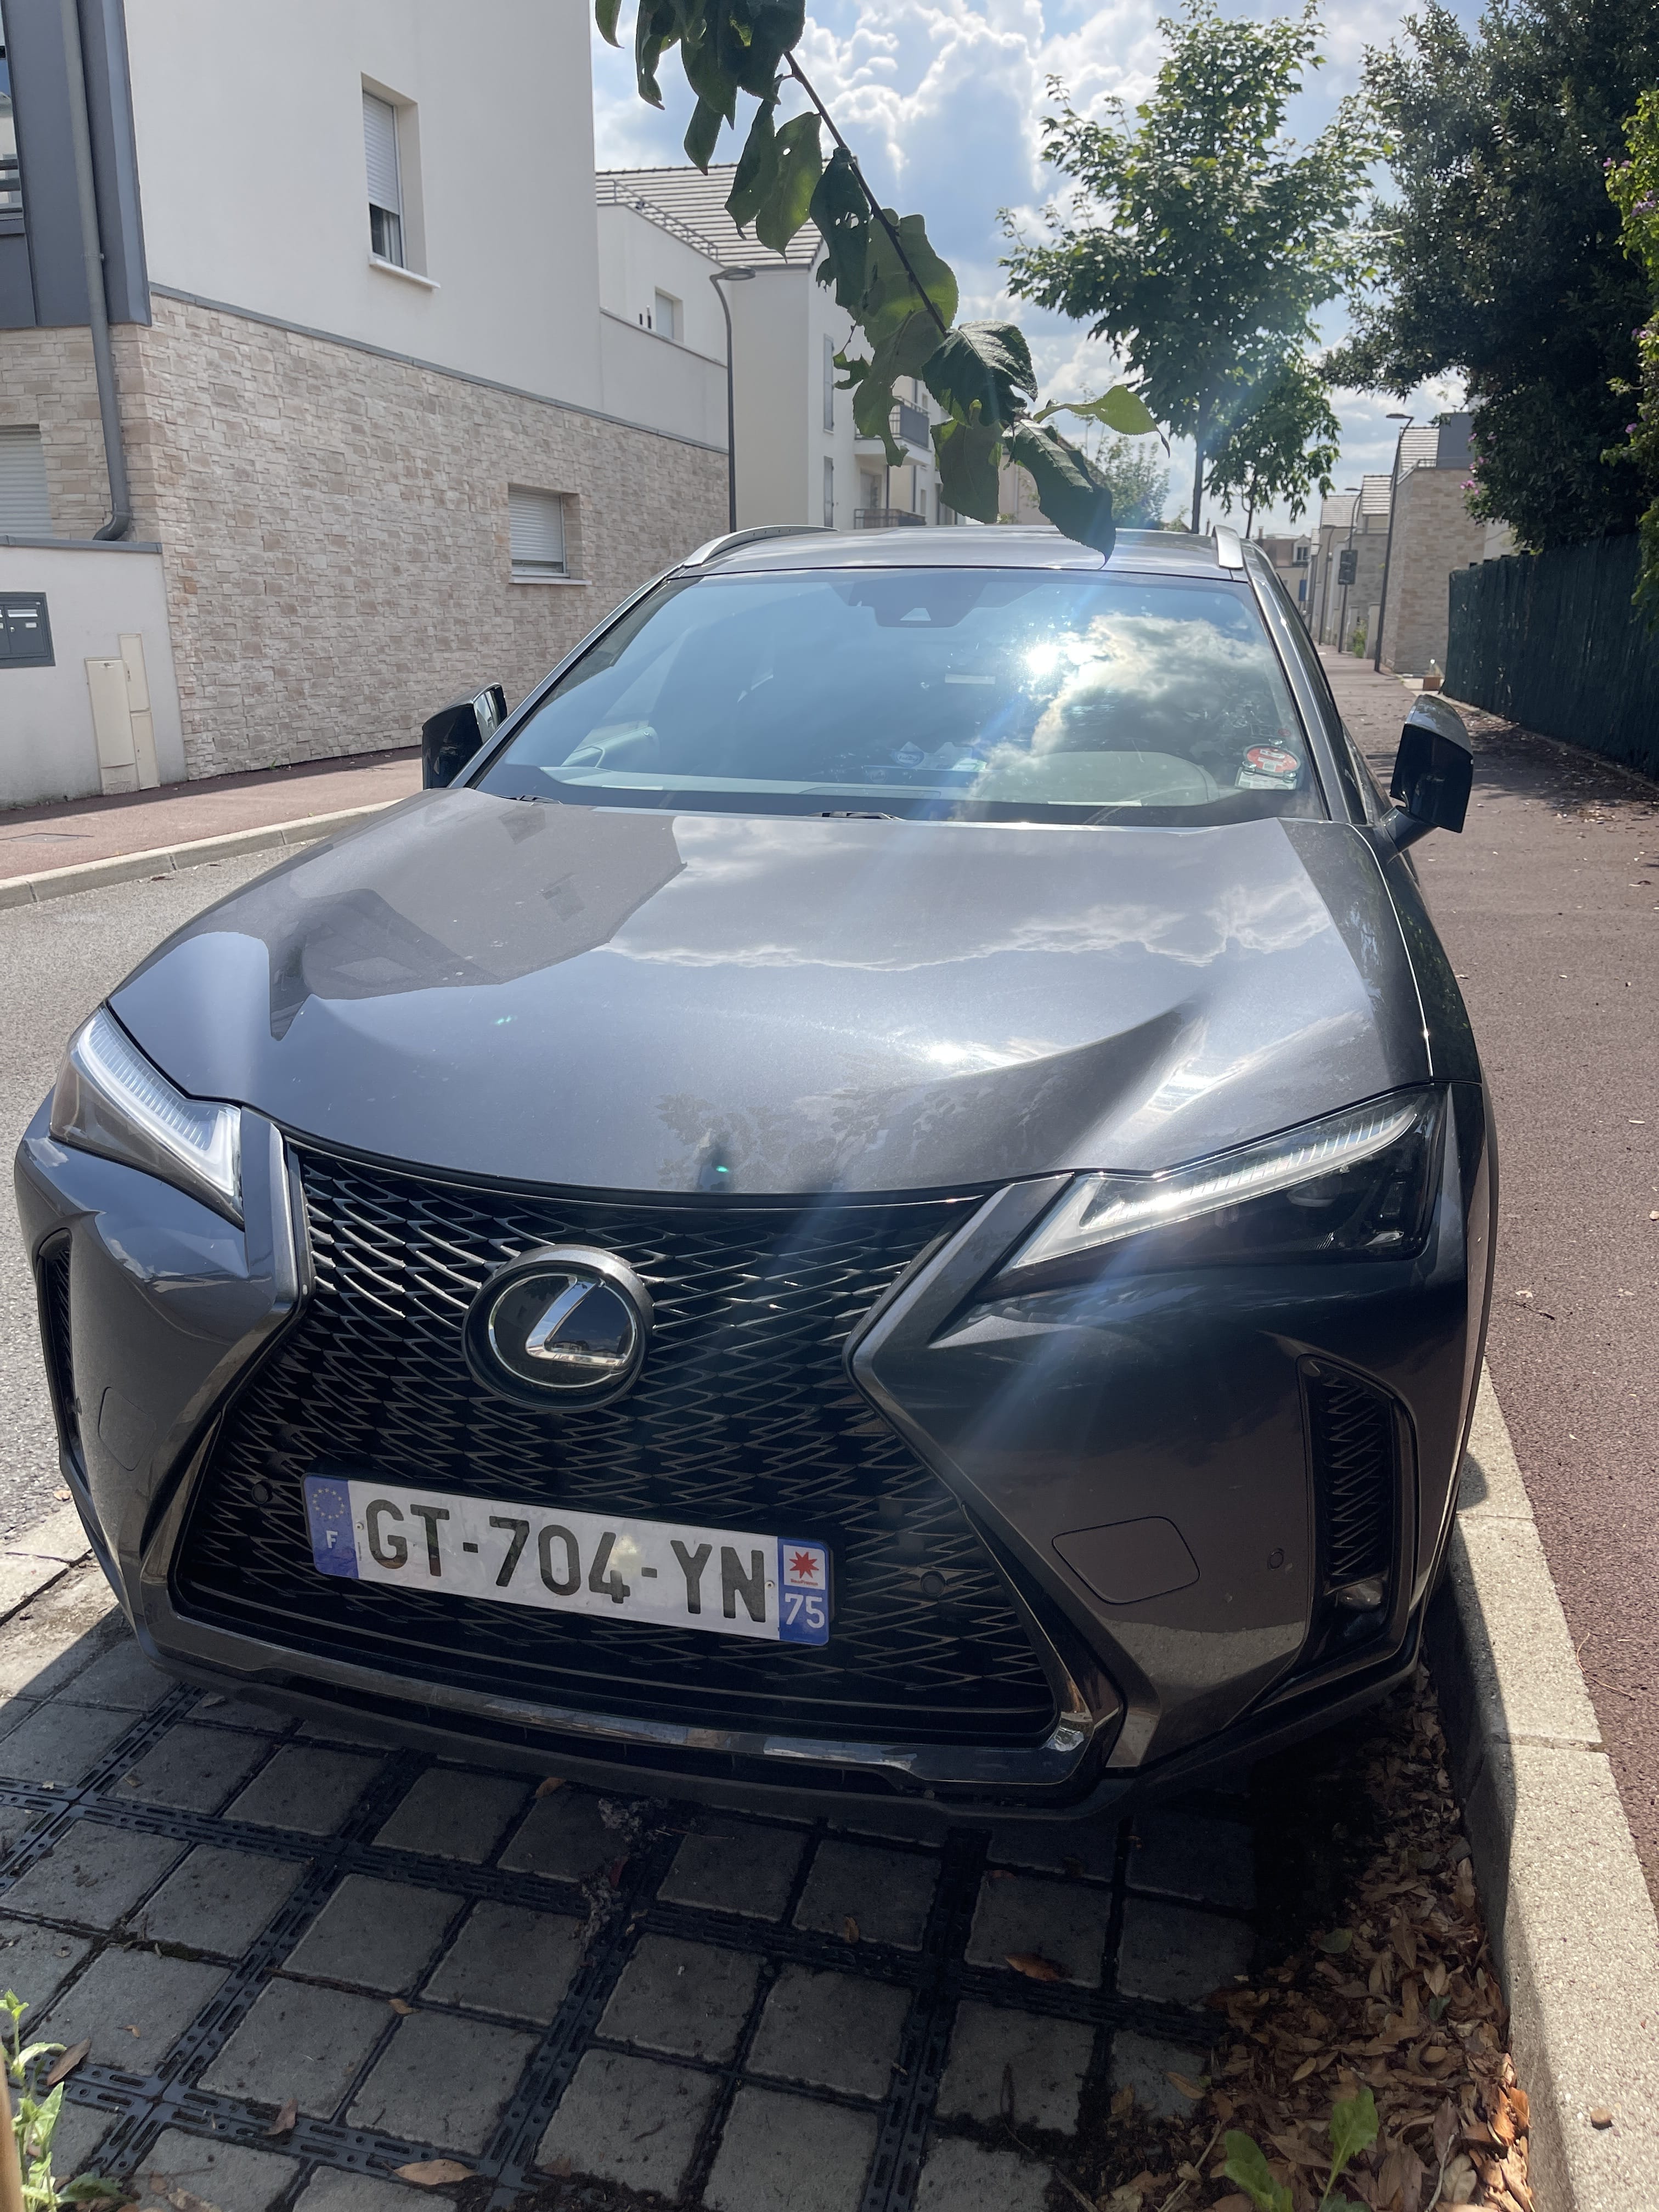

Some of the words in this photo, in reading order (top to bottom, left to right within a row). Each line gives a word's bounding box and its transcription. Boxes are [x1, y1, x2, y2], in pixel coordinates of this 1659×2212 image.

[326, 1530, 338, 1549] F
[366, 1499, 766, 1623] GT-704-YN
[785, 1593, 825, 1629] 75
